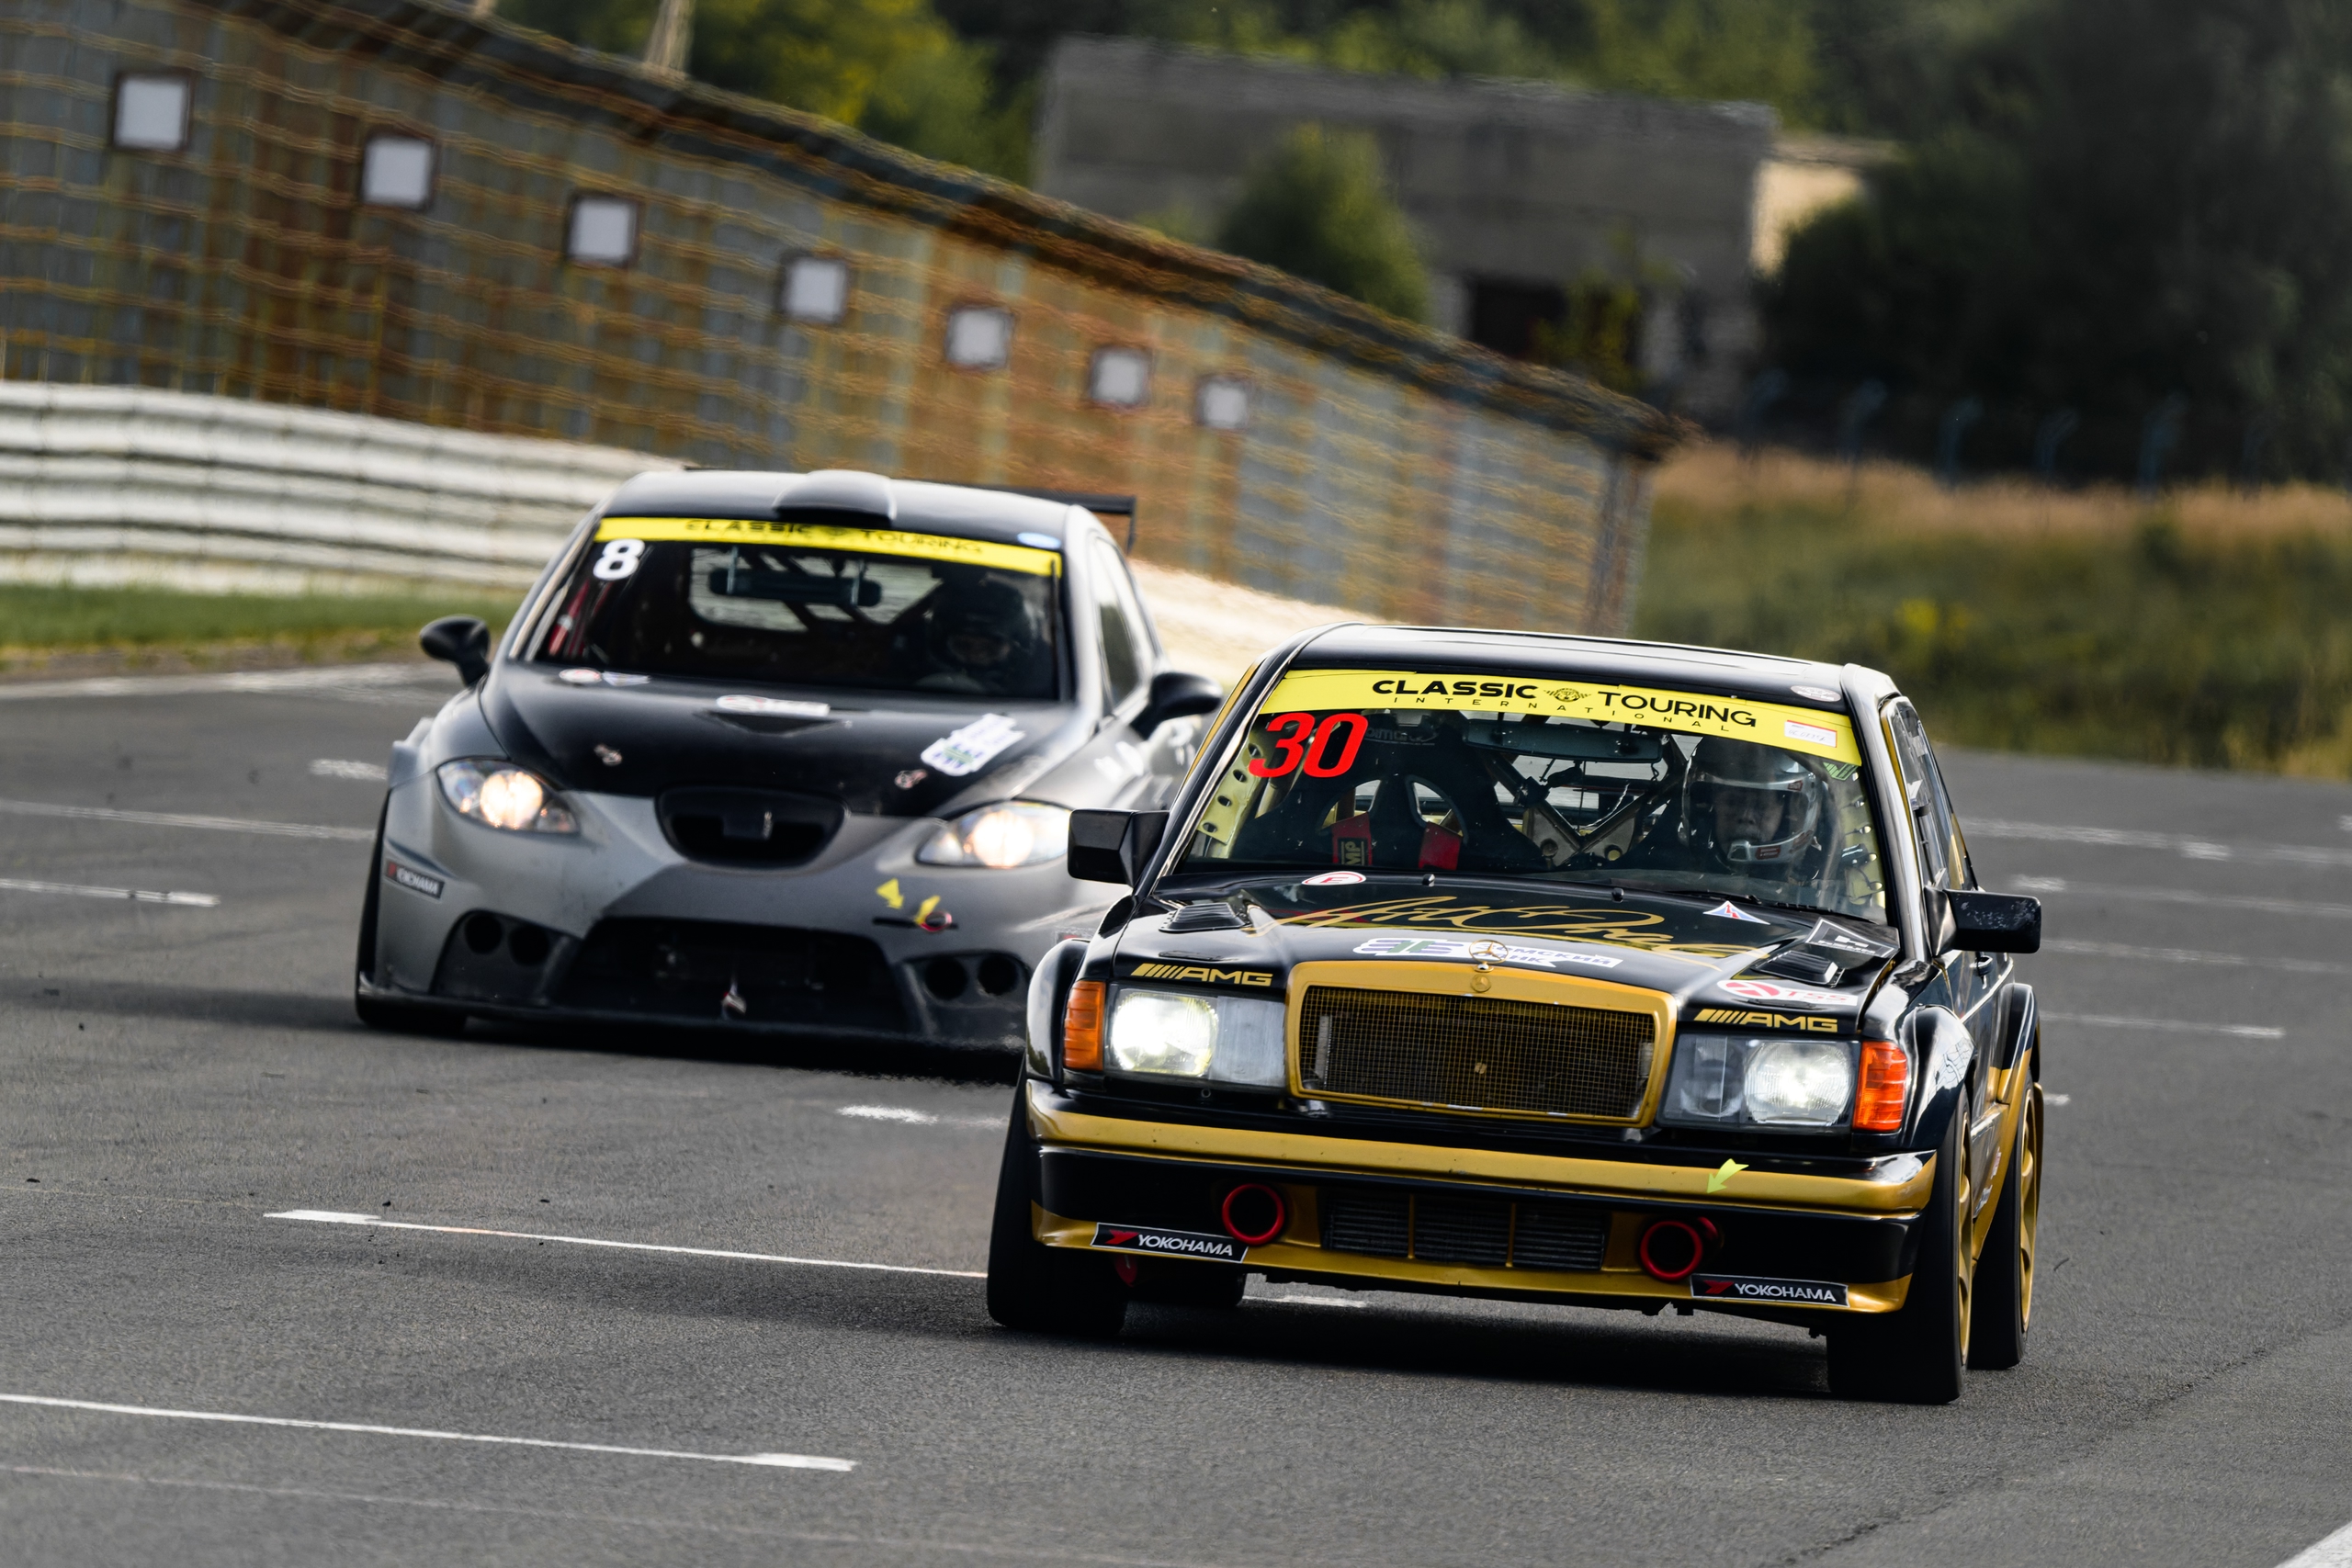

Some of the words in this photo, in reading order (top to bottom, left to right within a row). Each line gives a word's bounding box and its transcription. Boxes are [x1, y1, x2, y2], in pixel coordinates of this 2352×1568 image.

[593, 538, 645, 581] 8
[1372, 680, 1539, 700] CLASSIC
[1597, 691, 1757, 728] TOURING
[1394, 696, 1729, 732] INTERNATIONAL
[1249, 713, 1368, 778] 30
[1174, 965, 1273, 987] AMG
[1739, 1011, 1838, 1033] AMG
[1137, 1234, 1233, 1257] YOKOHAMA
[1734, 1283, 1837, 1303] YOKOHAMA
